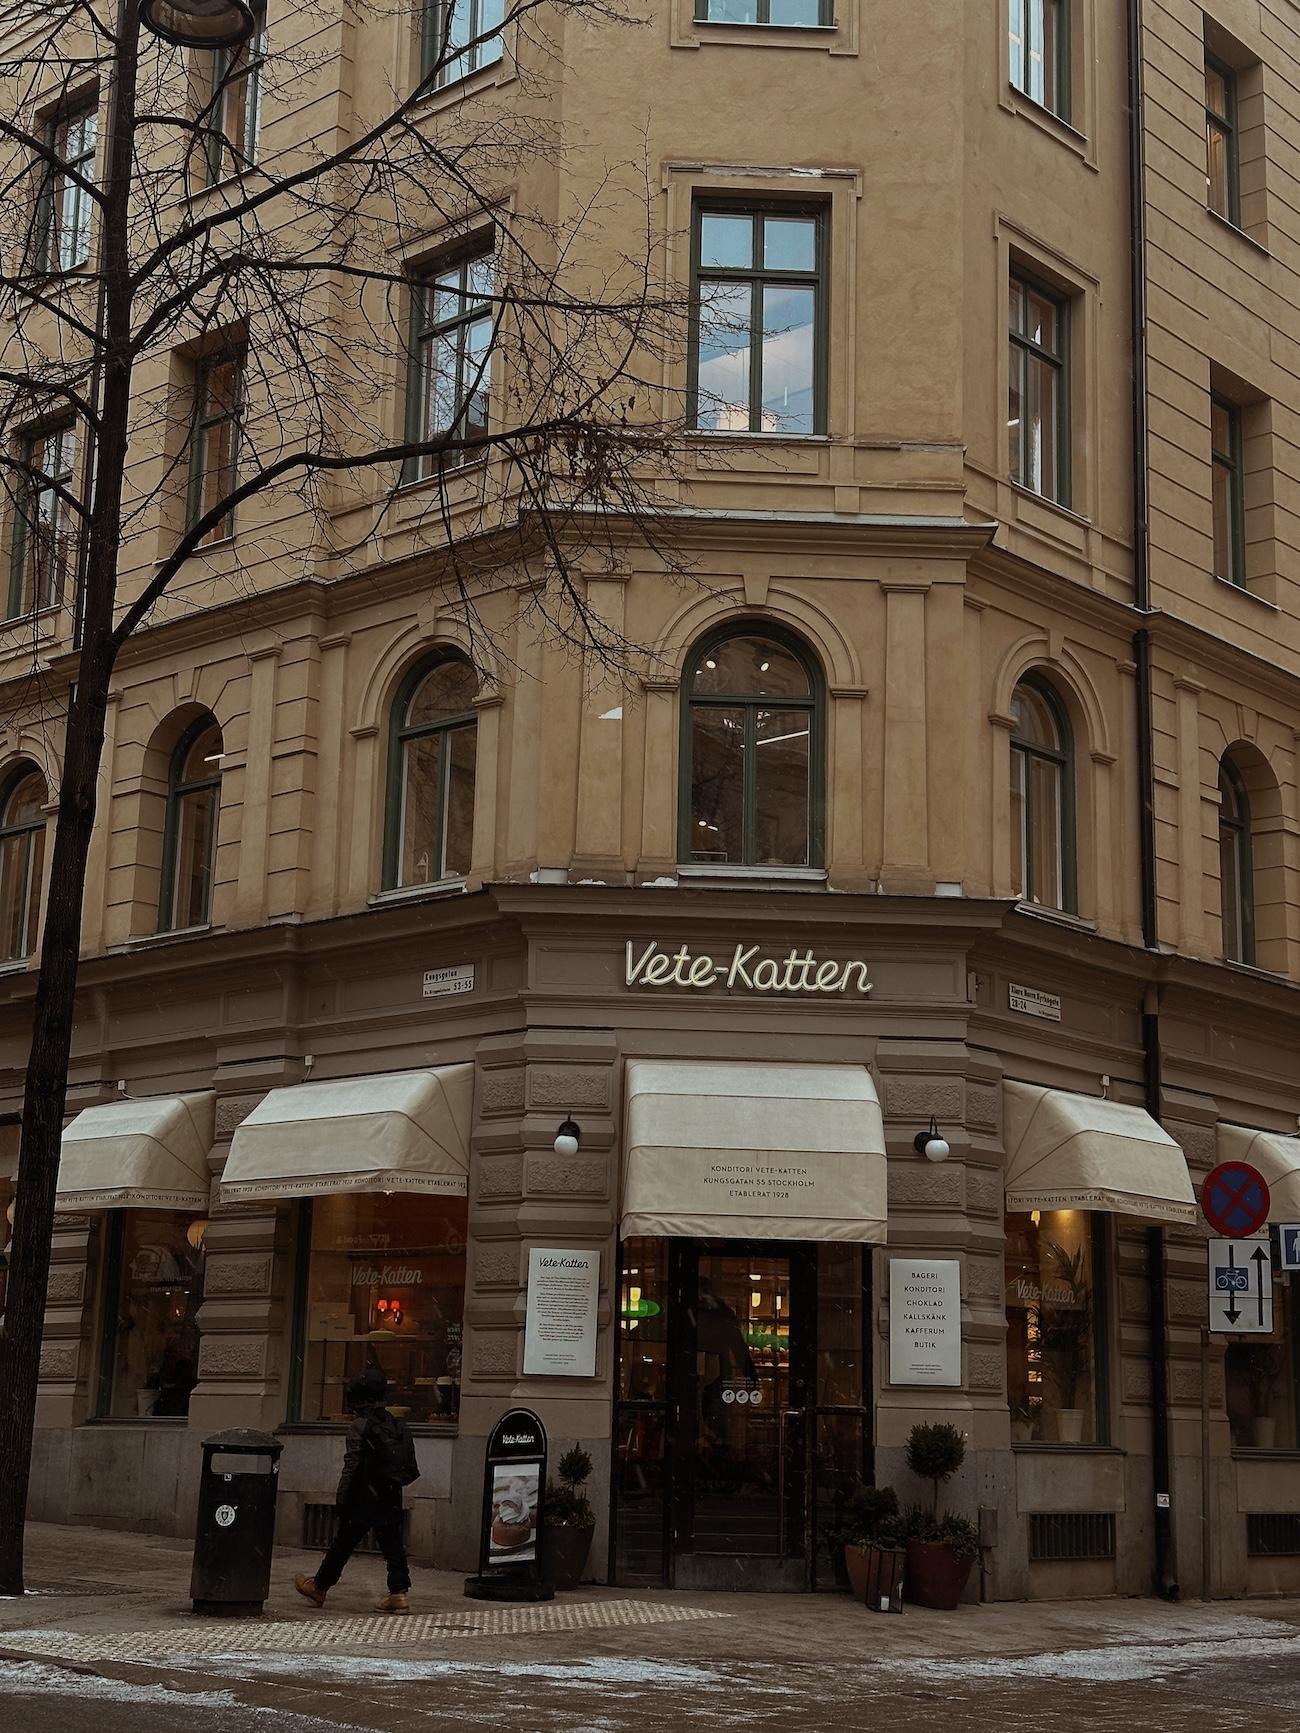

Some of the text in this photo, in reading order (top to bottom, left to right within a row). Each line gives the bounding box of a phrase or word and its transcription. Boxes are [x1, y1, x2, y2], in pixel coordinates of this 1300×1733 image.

[625, 939, 874, 993] Vete-Katten
[425, 970, 457, 982] Kungsgatan
[454, 980, 472, 991] 53-55
[711, 1165, 807, 1175] KONDITORI VETE-KATTEN
[386, 1177, 426, 1186] VETE-KATTEN
[427, 1179, 457, 1188] ETABLERAT
[703, 1177, 815, 1187] KUNGSGATAN 55 STOCKHOLM
[729, 1190, 789, 1199] ETABLERAT 1928
[539, 1257, 589, 1269] Vete-Katten
[352, 1264, 423, 1286] Vete-Katten
[911, 1272, 938, 1280] BAGERI
[904, 1285, 945, 1294] KONDITORI
[1016, 1279, 1076, 1304] Vete-Katten
[906, 1299, 943, 1308] CHOKLAD
[903, 1313, 947, 1321] KALLSKÄNK
[905, 1327, 945, 1335] KAFFERUM
[914, 1341, 937, 1349] BUTIK
[502, 1434, 535, 1444] Vete-Katten
